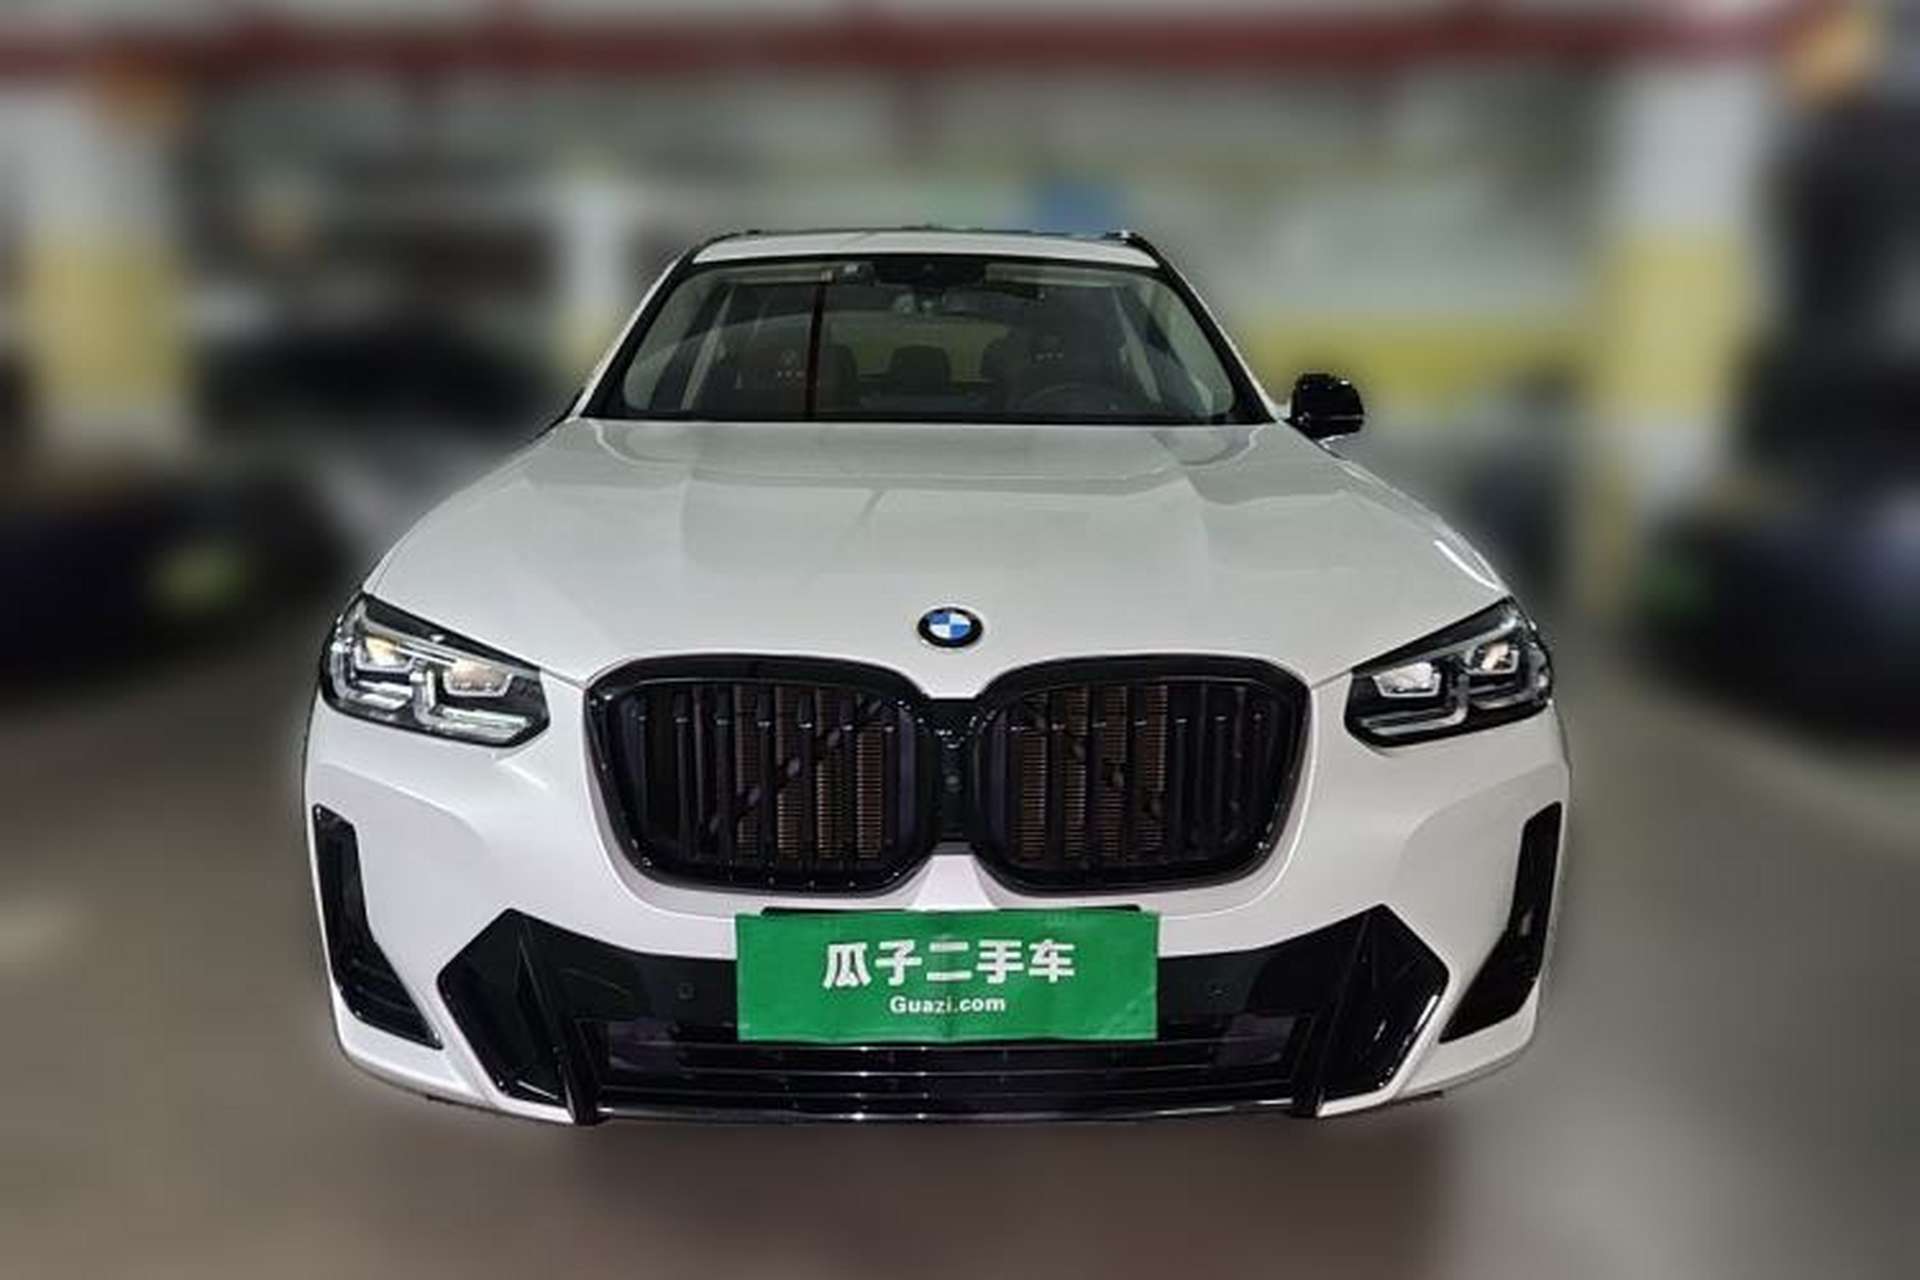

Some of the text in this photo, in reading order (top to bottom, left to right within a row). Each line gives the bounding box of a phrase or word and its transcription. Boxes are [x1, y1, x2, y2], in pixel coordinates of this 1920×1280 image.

[822, 939, 1076, 988] 瓜子二手车
[889, 995, 1006, 1014] Guazi.com
